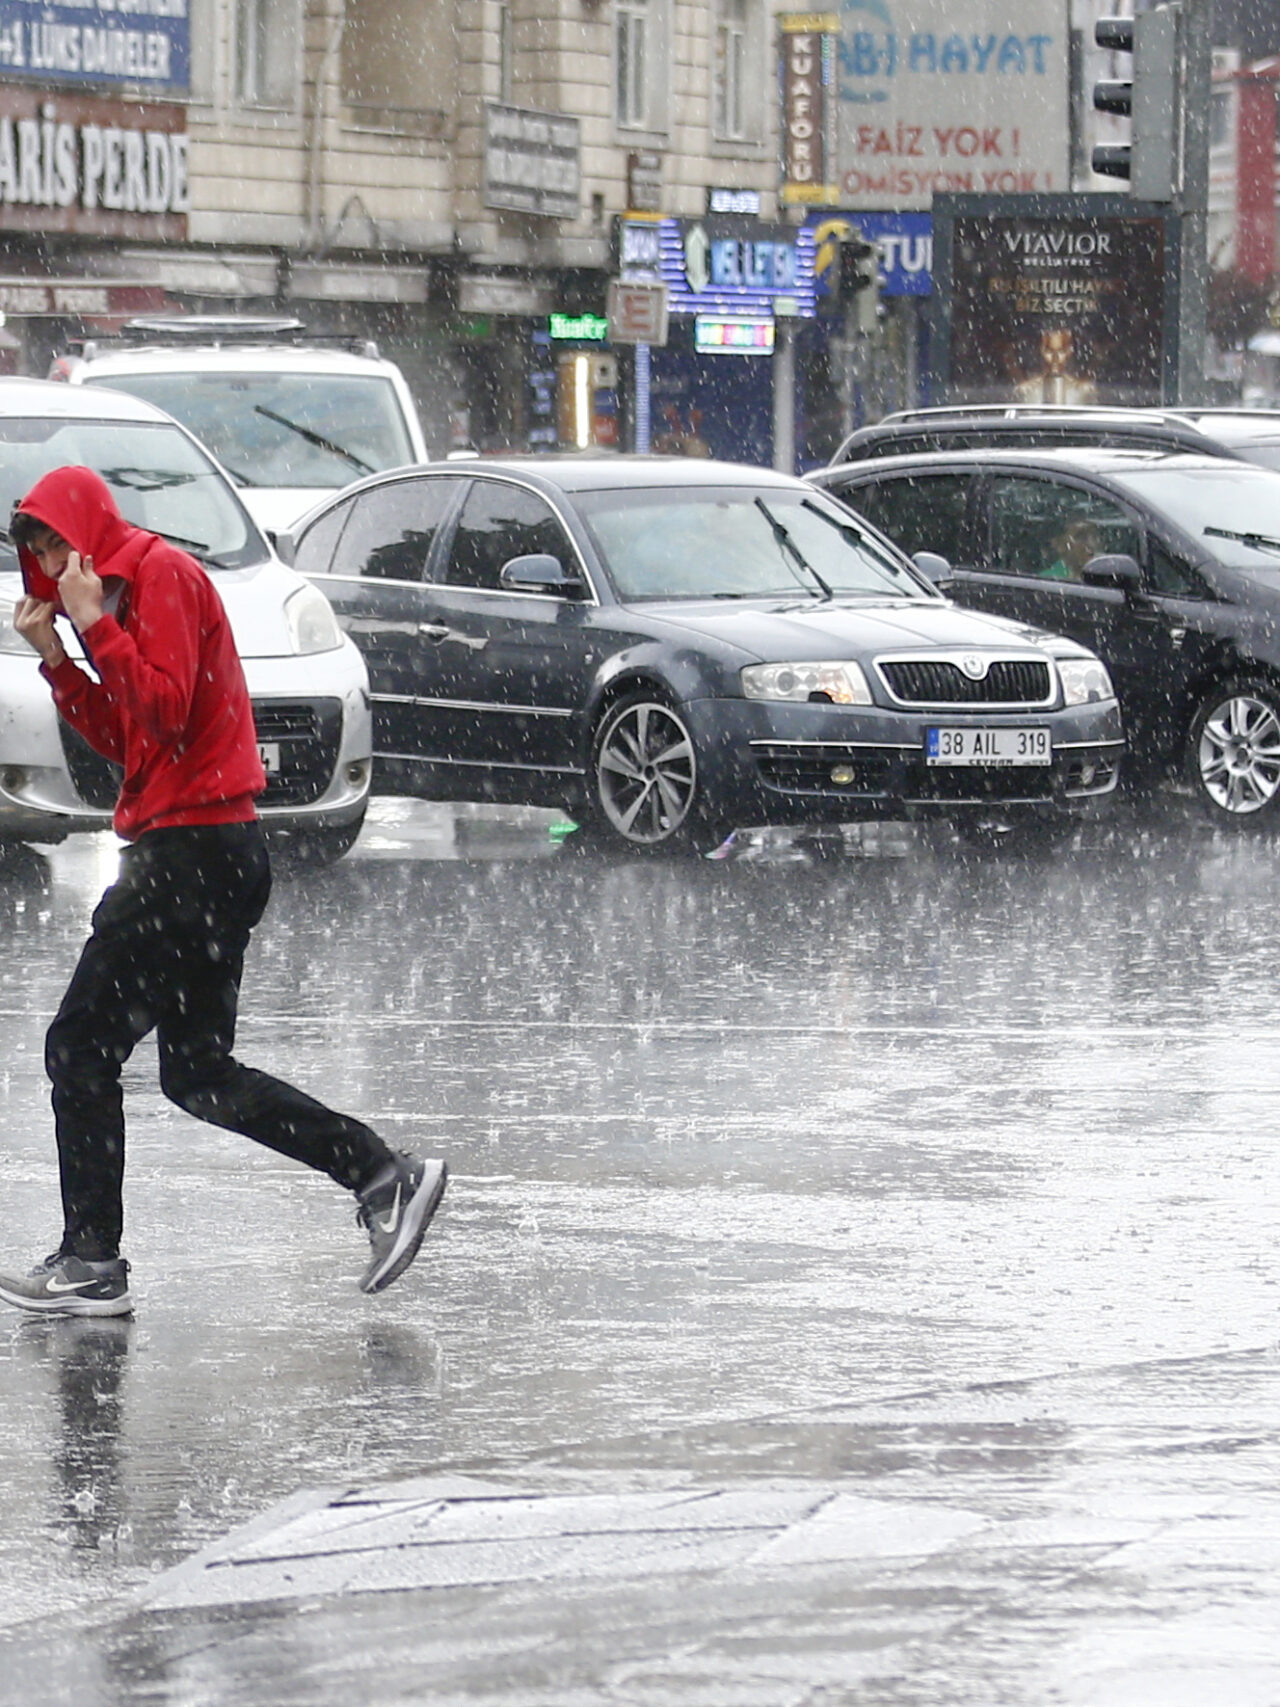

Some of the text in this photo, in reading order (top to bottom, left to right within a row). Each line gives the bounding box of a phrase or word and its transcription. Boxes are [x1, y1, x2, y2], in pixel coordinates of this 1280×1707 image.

[909, 33, 1052, 75] HAYAT
[856, 120, 924, 156] FAİZ
[934, 126, 1002, 157] YOK
[82, 121, 191, 213] PERDE
[841, 165, 973, 195] OMİSYON
[983, 170, 1037, 191] YOK
[942, 732, 963, 755] 38
[973, 732, 1000, 755] AIL
[1017, 732, 1046, 755] 319
